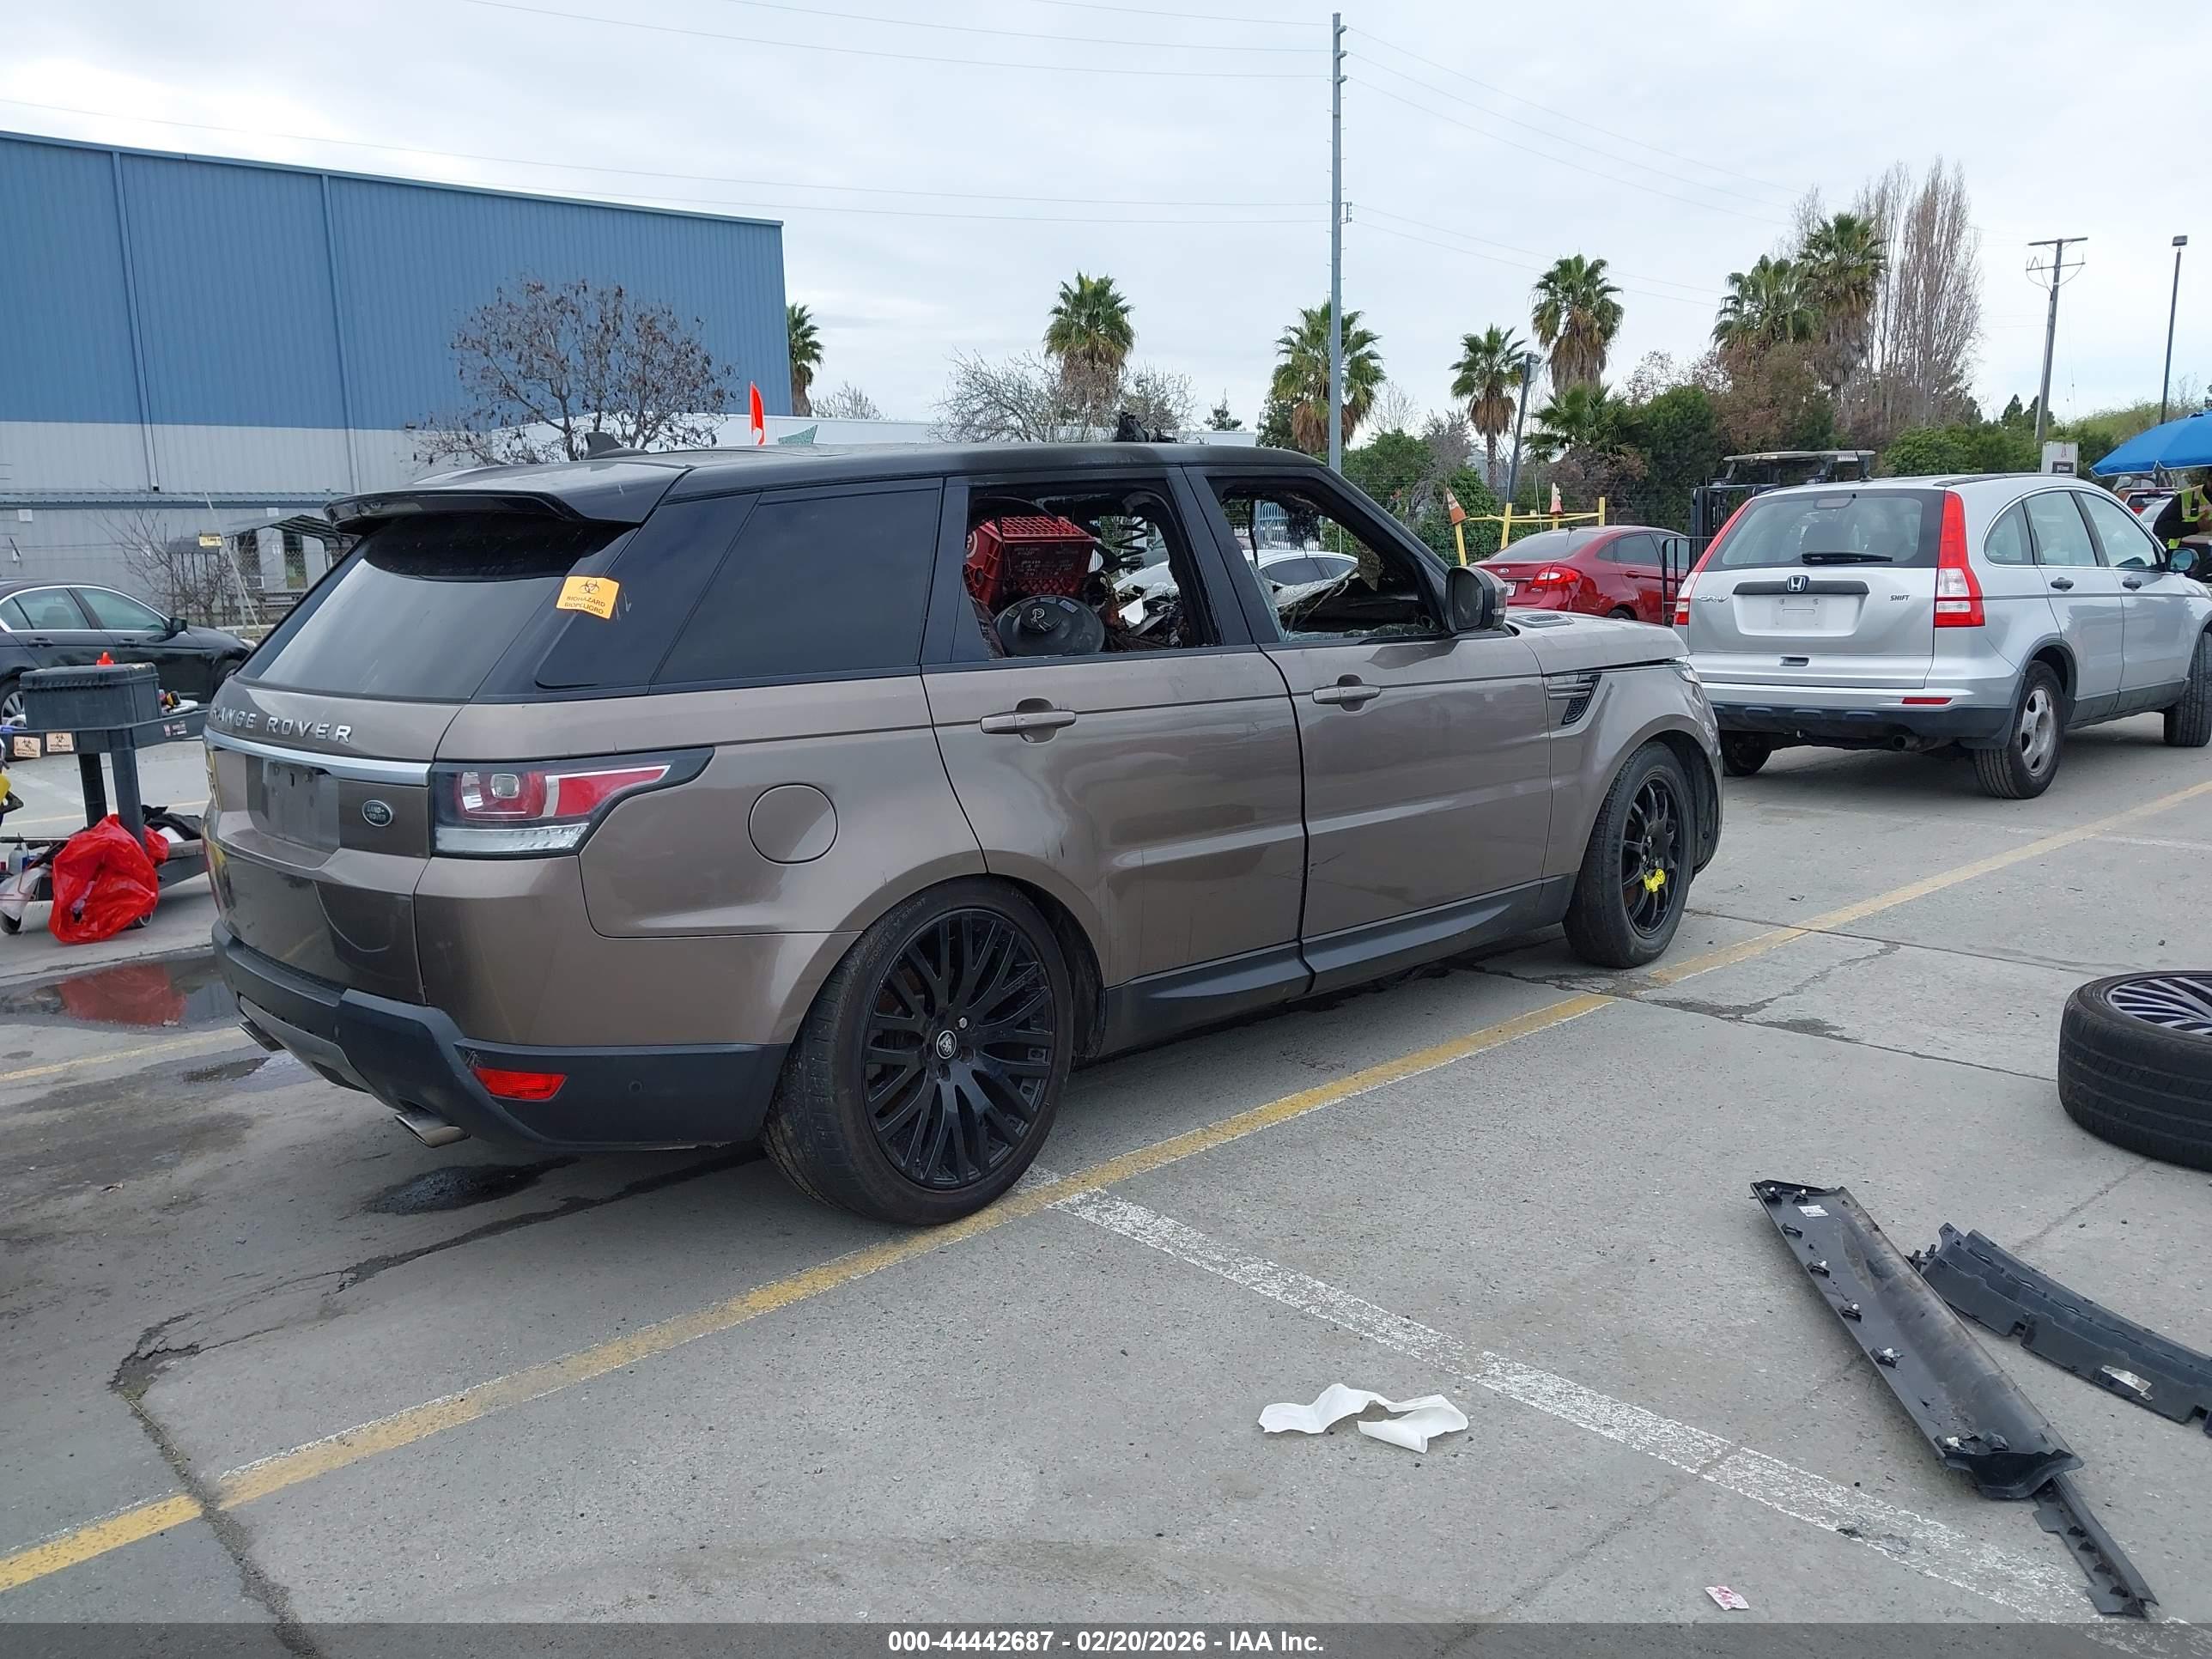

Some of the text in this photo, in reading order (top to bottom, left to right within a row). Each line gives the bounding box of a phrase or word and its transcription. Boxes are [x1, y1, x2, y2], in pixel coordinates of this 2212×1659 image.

[567, 596, 605, 607] BIOHAZARD
[564, 602, 604, 614] BIOPELIGRO
[267, 716, 352, 744] ROVER
